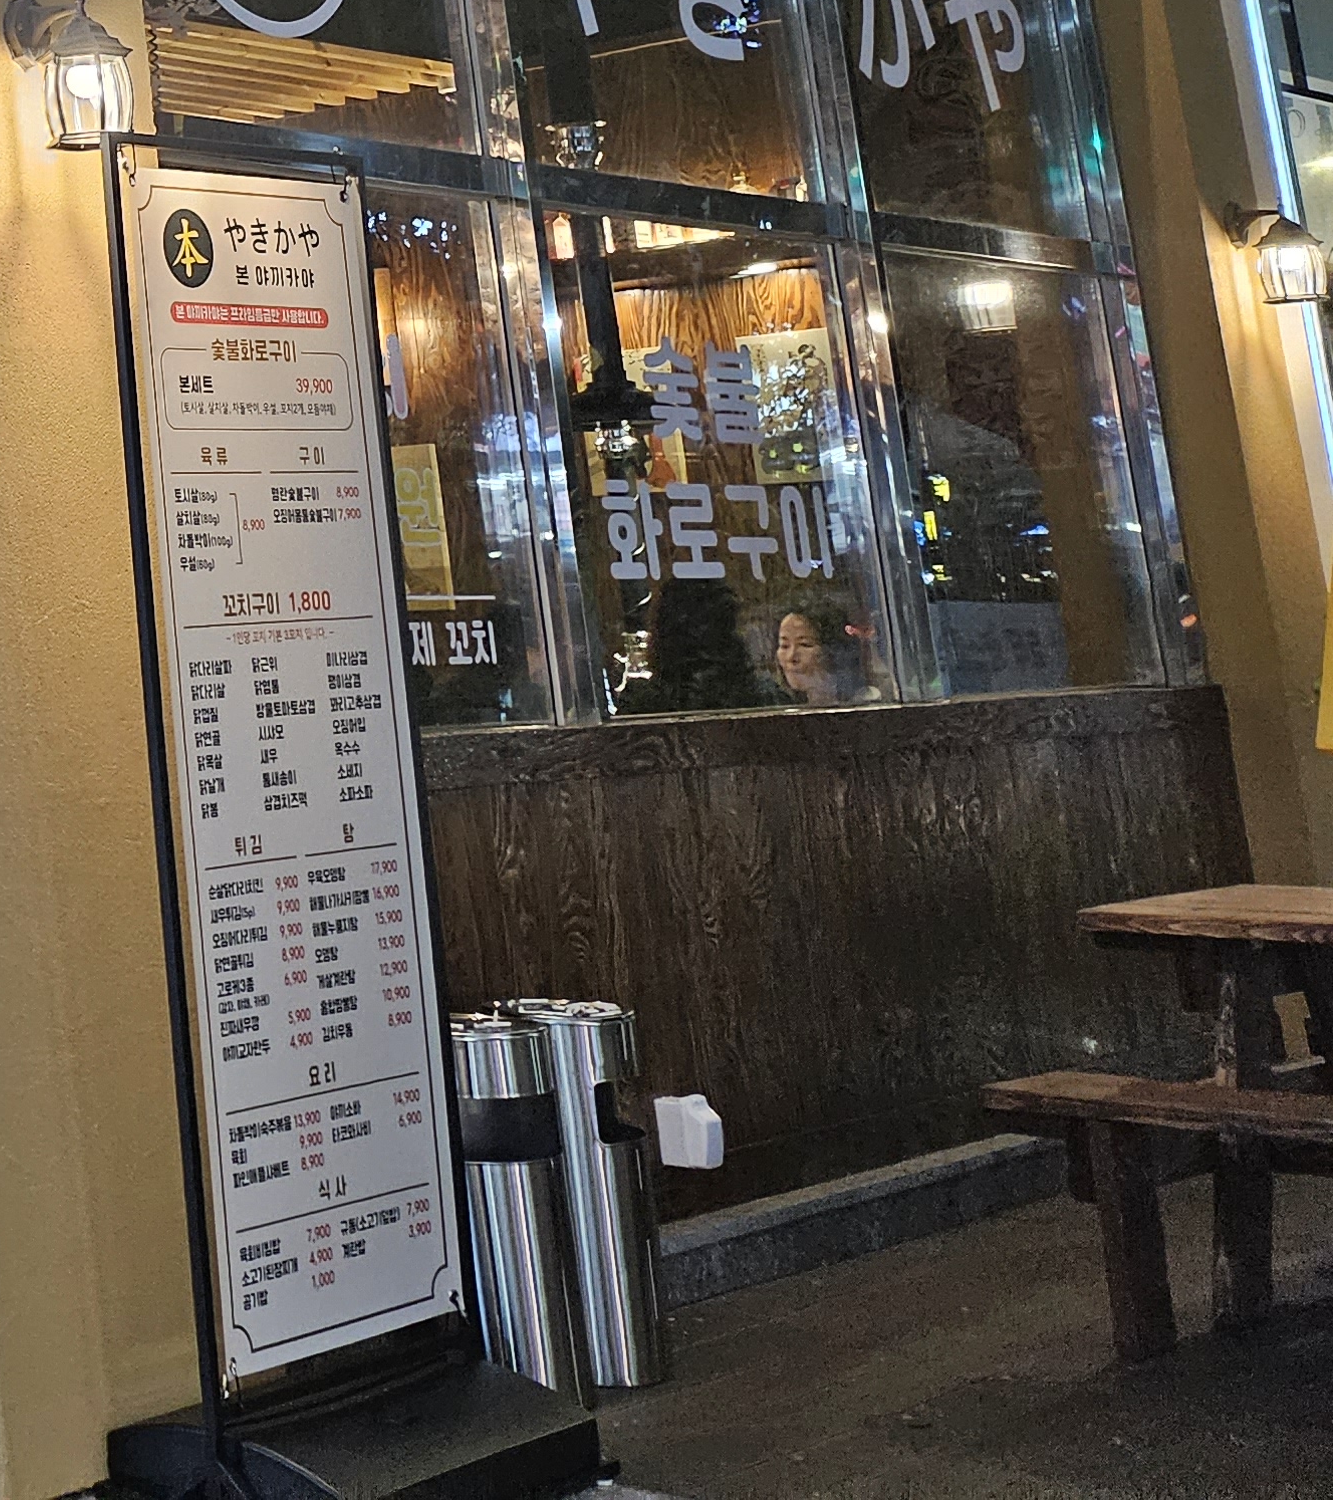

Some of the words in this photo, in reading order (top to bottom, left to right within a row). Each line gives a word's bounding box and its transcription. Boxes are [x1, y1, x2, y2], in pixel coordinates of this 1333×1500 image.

[172, 218, 209, 278] 本
[224, 218, 320, 257] やきかや
[235, 265, 249, 286] 본
[256, 266, 315, 289] 야끼카야
[175, 304, 185, 319] 본
[187, 305, 229, 321] 야끼카야는
[282, 308, 324, 324] 사용합니다.
[211, 338, 297, 363] 숯불화로구이
[179, 375, 214, 394] 본세트
[296, 378, 333, 396] 39,900
[643, 336, 765, 444] 숯불
[336, 486, 359, 499] 8,900
[338, 508, 362, 521] 7,900
[242, 519, 265, 533] 8,900
[601, 479, 834, 583] 화로구이
[222, 592, 280, 617] 꼬치구이
[289, 590, 331, 615] 1,800
[445, 620, 498, 667] 꼬치
[189, 659, 232, 678] 닭다리살파
[251, 656, 278, 673] 닭근위
[326, 651, 368, 667] 미나리삼겹
[191, 684, 226, 701] 닭다리살
[254, 679, 280, 696] 닭염통
[255, 699, 316, 719] 방울토마토삼겹
[332, 717, 366, 735] 오징어입
[194, 730, 222, 748] 닭연골
[334, 740, 361, 757] 옥수수
[196, 754, 223, 772] 닭목살
[260, 748, 279, 765] 새우
[262, 769, 298, 789] 통새송이
[337, 762, 363, 780] 소세지
[199, 777, 225, 796] 닭날개
[201, 802, 219, 820] 닭봉
[342, 822, 355, 843] 탕
[371, 859, 398, 876] 17,900
[208, 877, 264, 901] 순살닭다리치킨
[275, 875, 299, 893] 9,900
[372, 884, 400, 902] 16,900
[276, 898, 301, 916] 9,900
[375, 909, 403, 926] 15,900
[212, 925, 269, 950] 오징어다리튀김
[279, 922, 303, 941] 9,900
[214, 952, 255, 974] 닭연골튀김
[379, 959, 408, 978] 12,900
[284, 969, 308, 988] 6,900
[288, 1007, 312, 1025] 5,900
[290, 1031, 314, 1050] 4,900
[322, 1022, 354, 1044] 김치우동
[294, 1110, 322, 1129] 13,900
[299, 1131, 323, 1150] 9,900
[332, 1120, 372, 1143] 타코와사비
[300, 1152, 325, 1171] 8,900
[406, 1198, 430, 1218] 7,900
[306, 1223, 332, 1244] 7,900
[408, 1220, 432, 1240] 3,900
[308, 1246, 333, 1267] 4,900
[243, 1290, 269, 1311] 공기밥
[311, 1270, 336, 1291] 1,000
